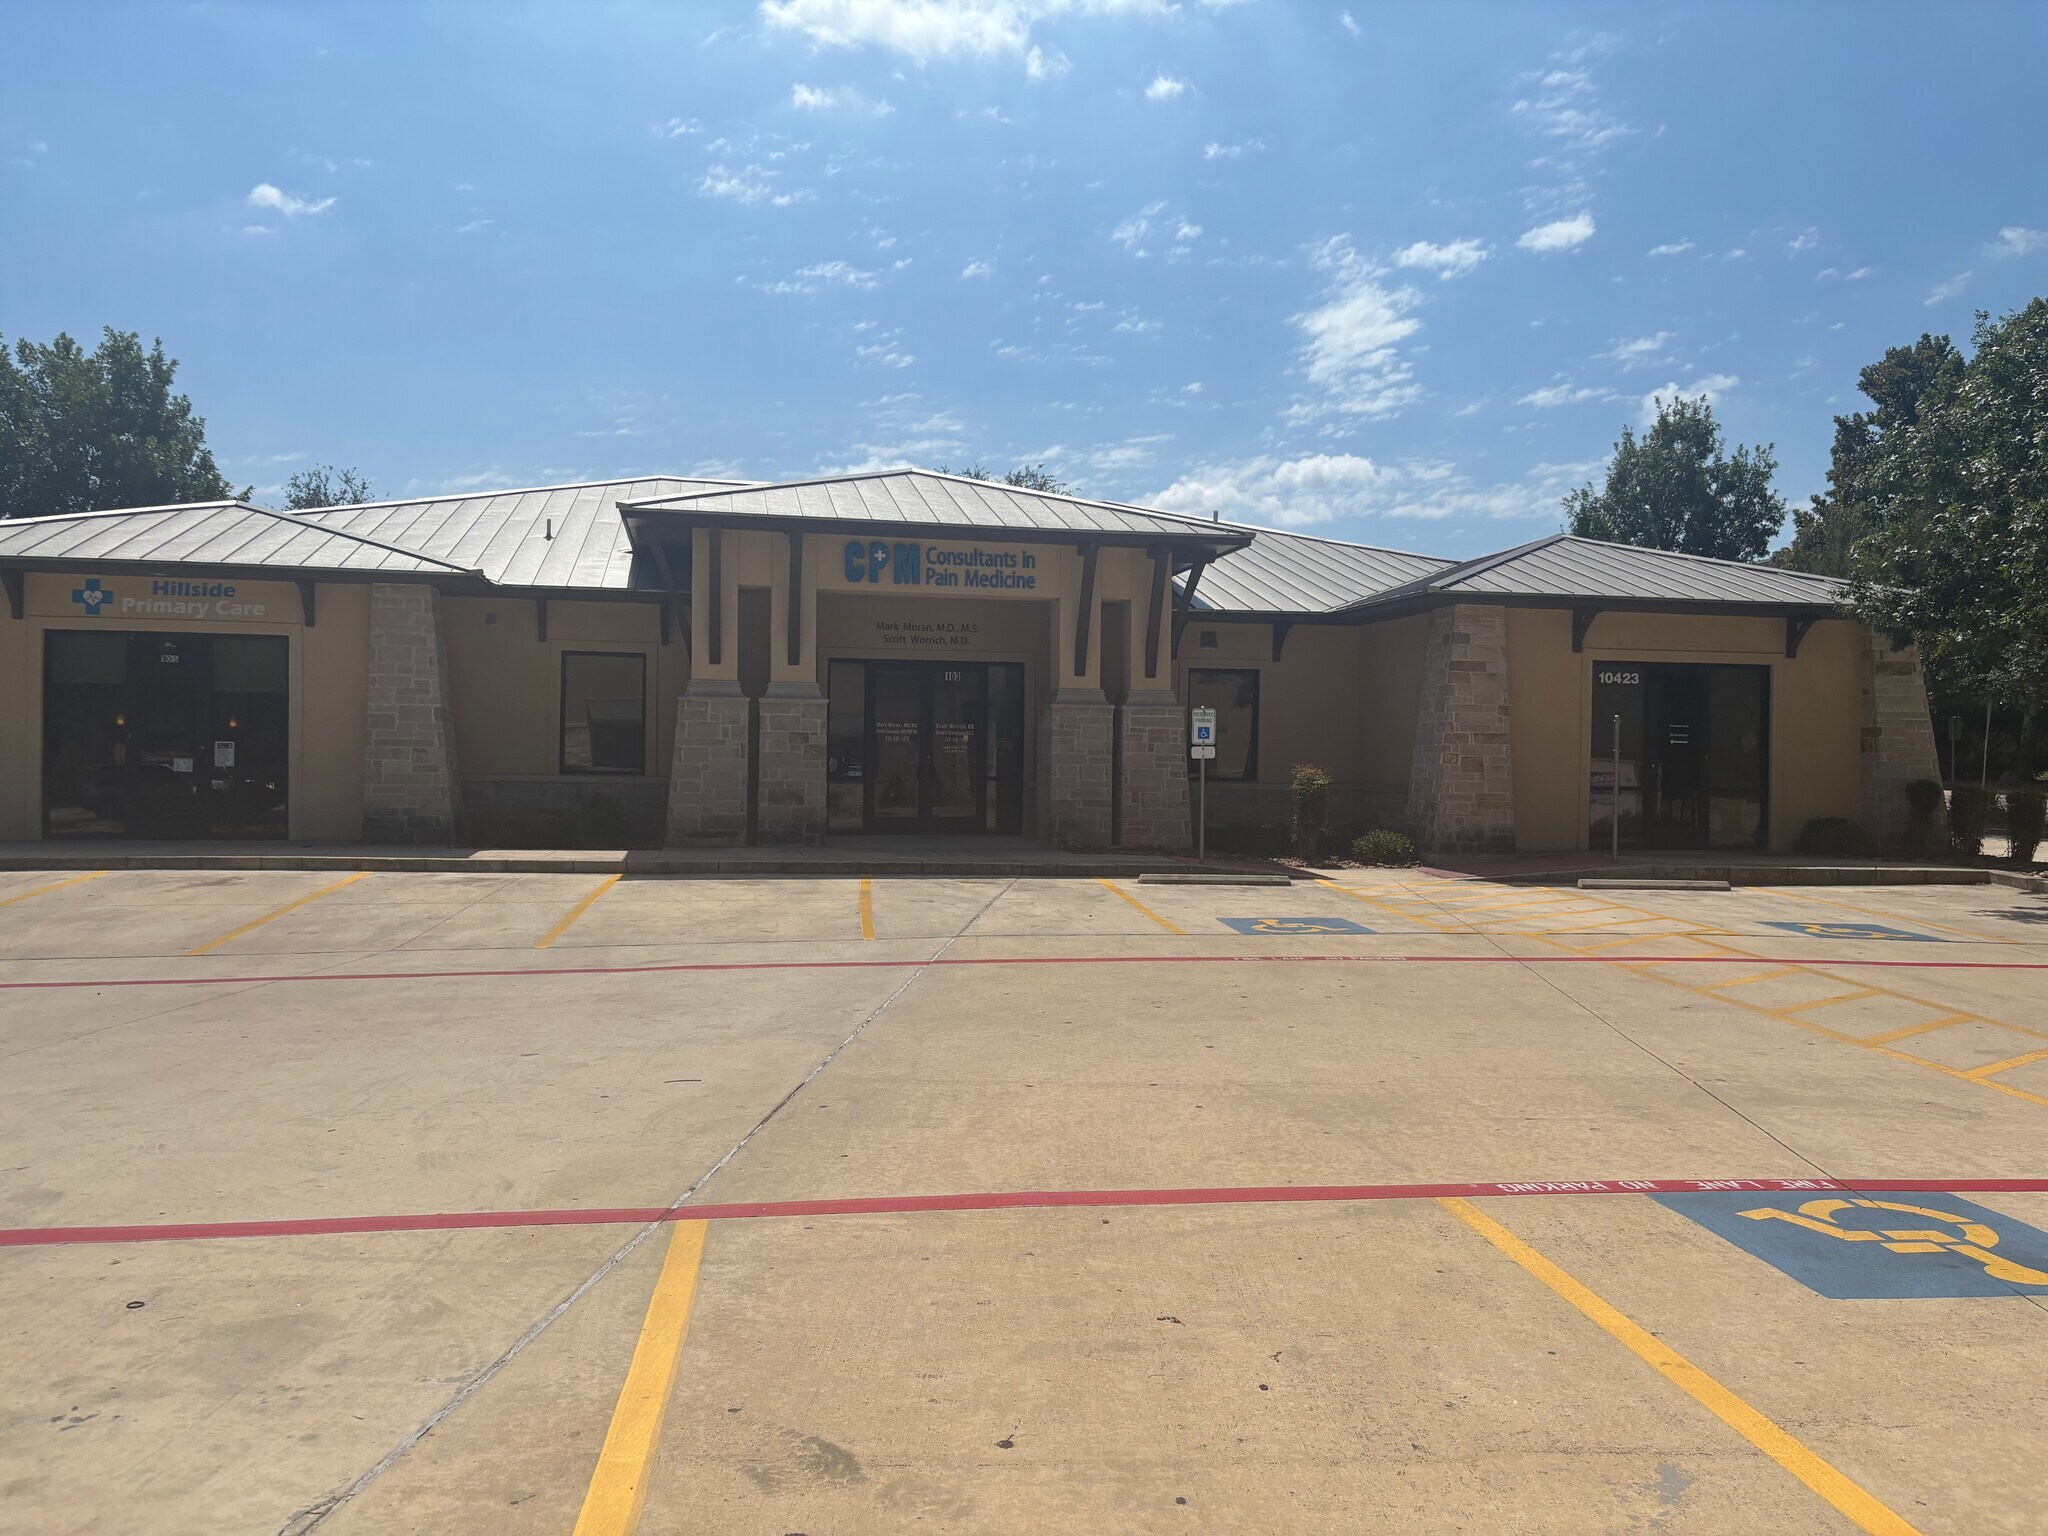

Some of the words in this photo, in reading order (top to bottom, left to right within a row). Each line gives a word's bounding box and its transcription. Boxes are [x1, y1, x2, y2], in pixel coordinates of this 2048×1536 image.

[844, 540, 921, 585] CPM
[926, 546, 1017, 569] Consultants
[1022, 550, 1036, 569] in
[926, 567, 958, 587] Pain
[964, 569, 1036, 589] Medicine
[152, 580, 236, 598] Hillside
[121, 597, 209, 618] Primary
[215, 600, 266, 616] Care
[876, 621, 899, 631] Mark
[903, 622, 935, 632] Moran,
[960, 624, 980, 633] M.S.
[883, 634, 906, 644] Scott
[910, 635, 948, 646] Worrich,
[949, 636, 970, 646] M.D.
[945, 671, 961, 681] 103
[1598, 672, 1640, 684] 10423
[1497, 1181, 1610, 1193] PARKING
[1618, 1180, 1660, 1190] NO
[1685, 1180, 1764, 1191] LANE
[1769, 1179, 1837, 1190] FIRE
